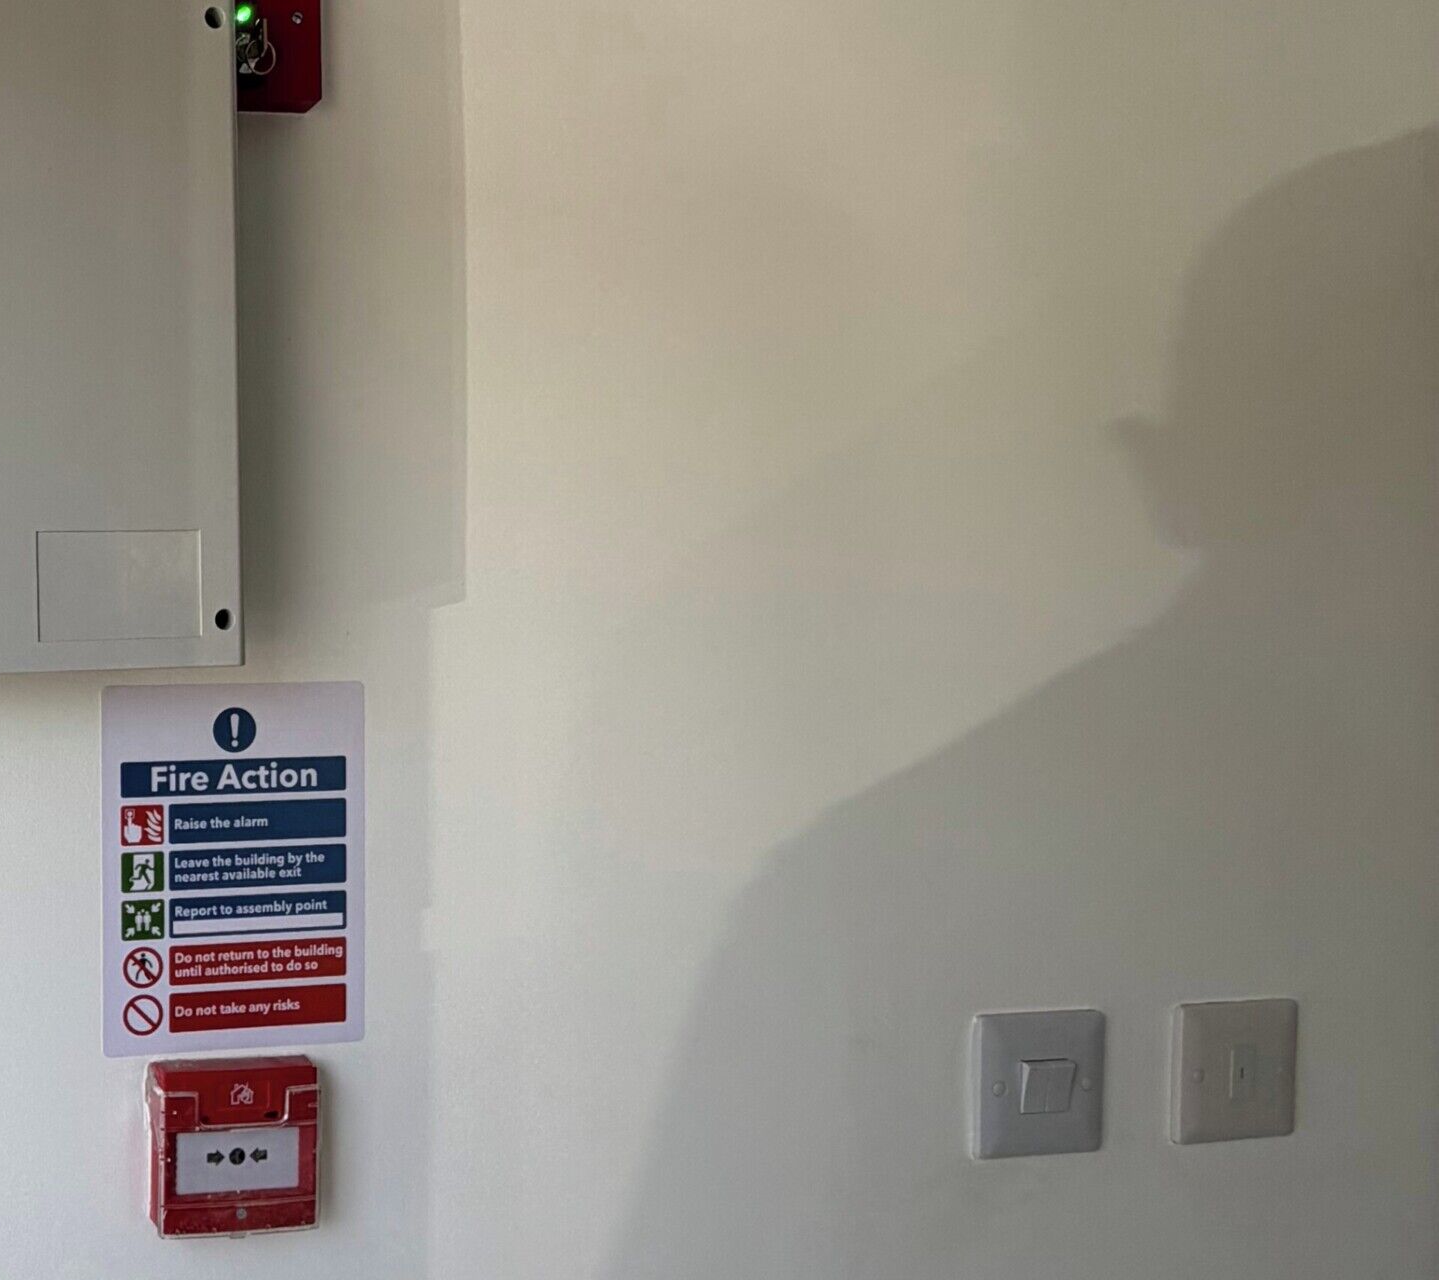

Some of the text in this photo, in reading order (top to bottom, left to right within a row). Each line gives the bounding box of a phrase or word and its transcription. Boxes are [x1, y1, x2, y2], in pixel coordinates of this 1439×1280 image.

[151, 761, 318, 792] Fire Action
[174, 816, 268, 830] Raise the alarm
[174, 851, 325, 869] Leave the building by the
[174, 866, 302, 883] nearest available exit
[174, 899, 328, 919] Report to assembly point
[174, 943, 343, 964] Do not return to the building
[175, 960, 318, 978] until authorised to do so
[174, 999, 300, 1018] Do not take any risks
